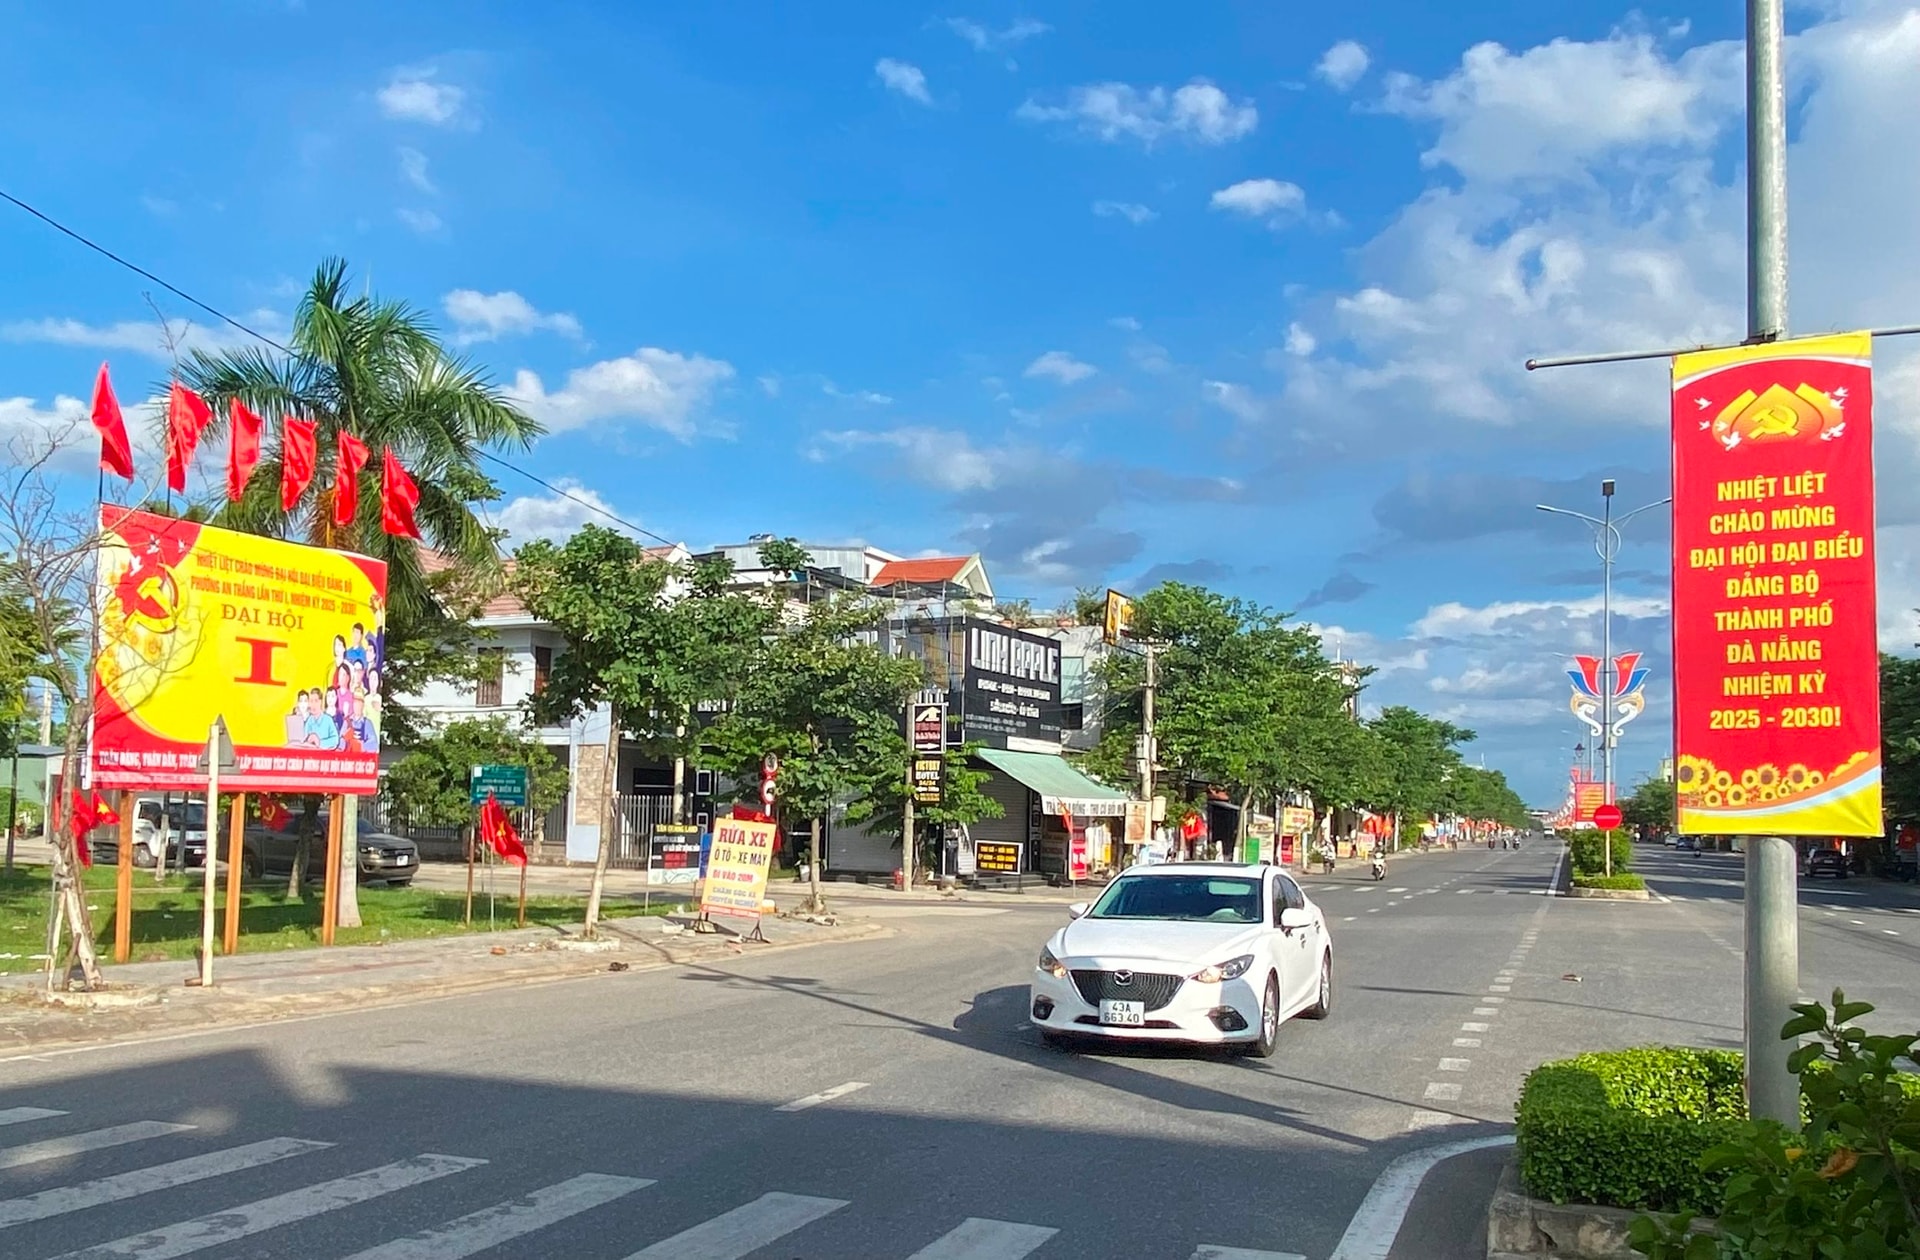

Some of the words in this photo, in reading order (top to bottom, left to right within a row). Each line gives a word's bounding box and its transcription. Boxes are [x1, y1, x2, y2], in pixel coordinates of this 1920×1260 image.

[1717, 475, 1777, 502] NHIỆT
[1783, 470, 1826, 498] LIỆT
[1709, 508, 1765, 534] CHÀO
[1771, 504, 1835, 529] MỪNG
[1690, 548, 1724, 571] ĐẠI
[1731, 542, 1765, 568] HỘI
[1771, 541, 1807, 566] ĐẠI
[1814, 530, 1863, 560] BIỂU
[222, 581, 232, 595] AN
[1726, 572, 1784, 598] ĐẢNG
[1790, 569, 1819, 598] BỘ
[221, 604, 261, 627] ĐẠI
[267, 608, 304, 632] HỘI
[1714, 606, 1783, 631] THÀNH
[1790, 599, 1834, 628] PHỐ
[234, 636, 288, 687] I
[971, 627, 1009, 675] LINH
[1010, 638, 1059, 685] APPLE
[1727, 640, 1755, 664] ĐÀ
[1761, 634, 1821, 661] NẴNG
[1723, 671, 1792, 699] NHIỆM
[1799, 669, 1826, 693] KỲ
[1710, 709, 1760, 729] 2025
[1781, 706, 1841, 727] 2030!
[718, 824, 745, 846] RỬA
[749, 831, 768, 847] XE
[714, 846, 720, 861] Ô
[722, 847, 731, 862] TÔ
[738, 851, 748, 864] XE
[750, 850, 767, 866] MÁY
[712, 869, 721, 879] ĐI
[722, 869, 736, 881] VÀO
[1112, 1002, 1131, 1013] 43A
